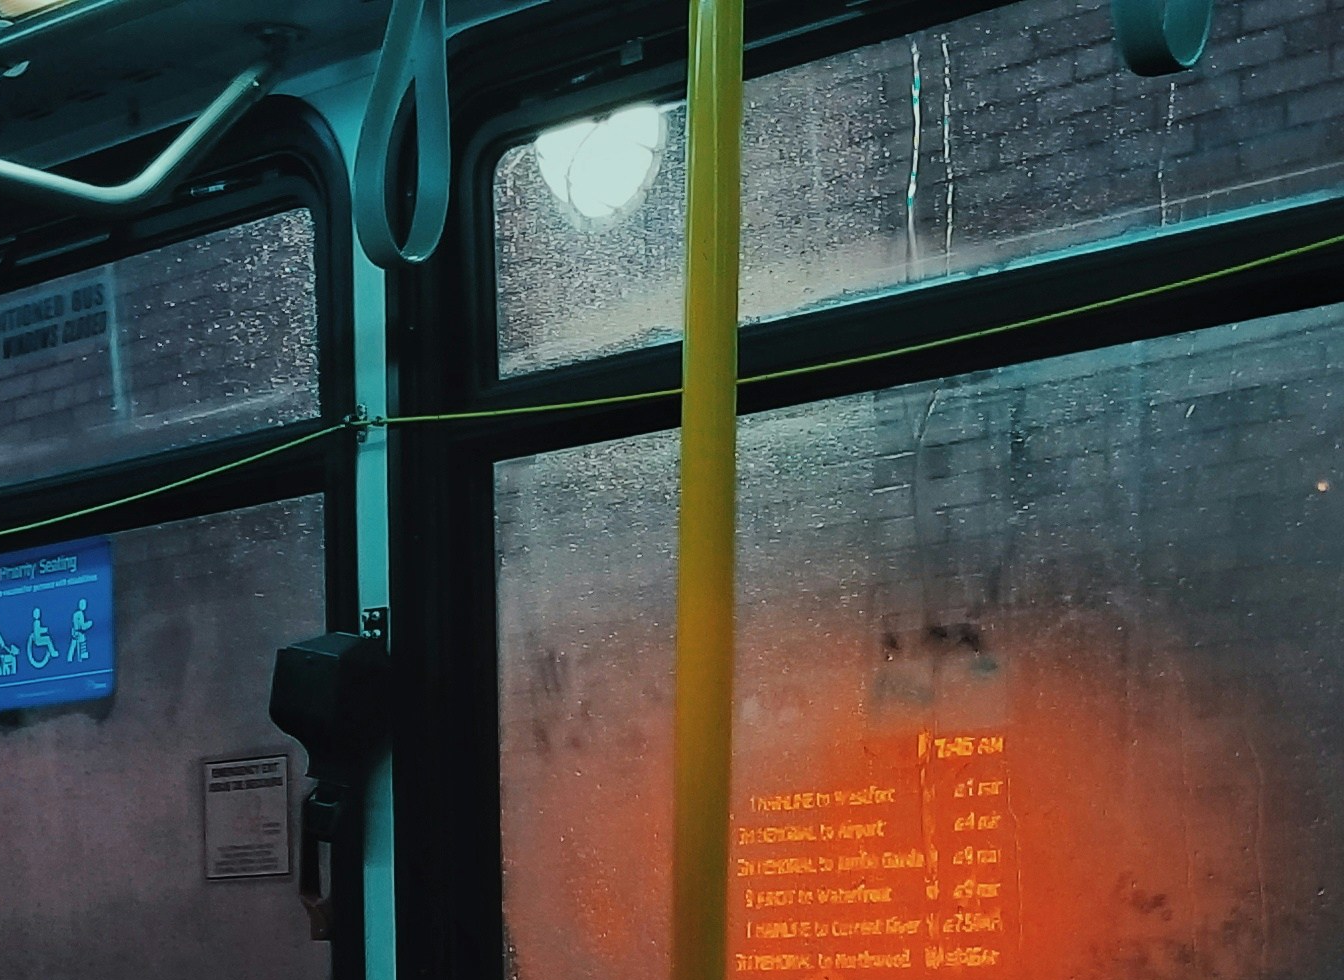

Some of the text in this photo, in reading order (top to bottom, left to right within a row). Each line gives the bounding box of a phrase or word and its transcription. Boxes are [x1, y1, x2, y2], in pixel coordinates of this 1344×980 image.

[72, 283, 104, 312] BUS
[3, 324, 58, 359] WINDOWS
[62, 311, 107, 343] CLOSED
[0, 555, 78, 581] Priority Seating
